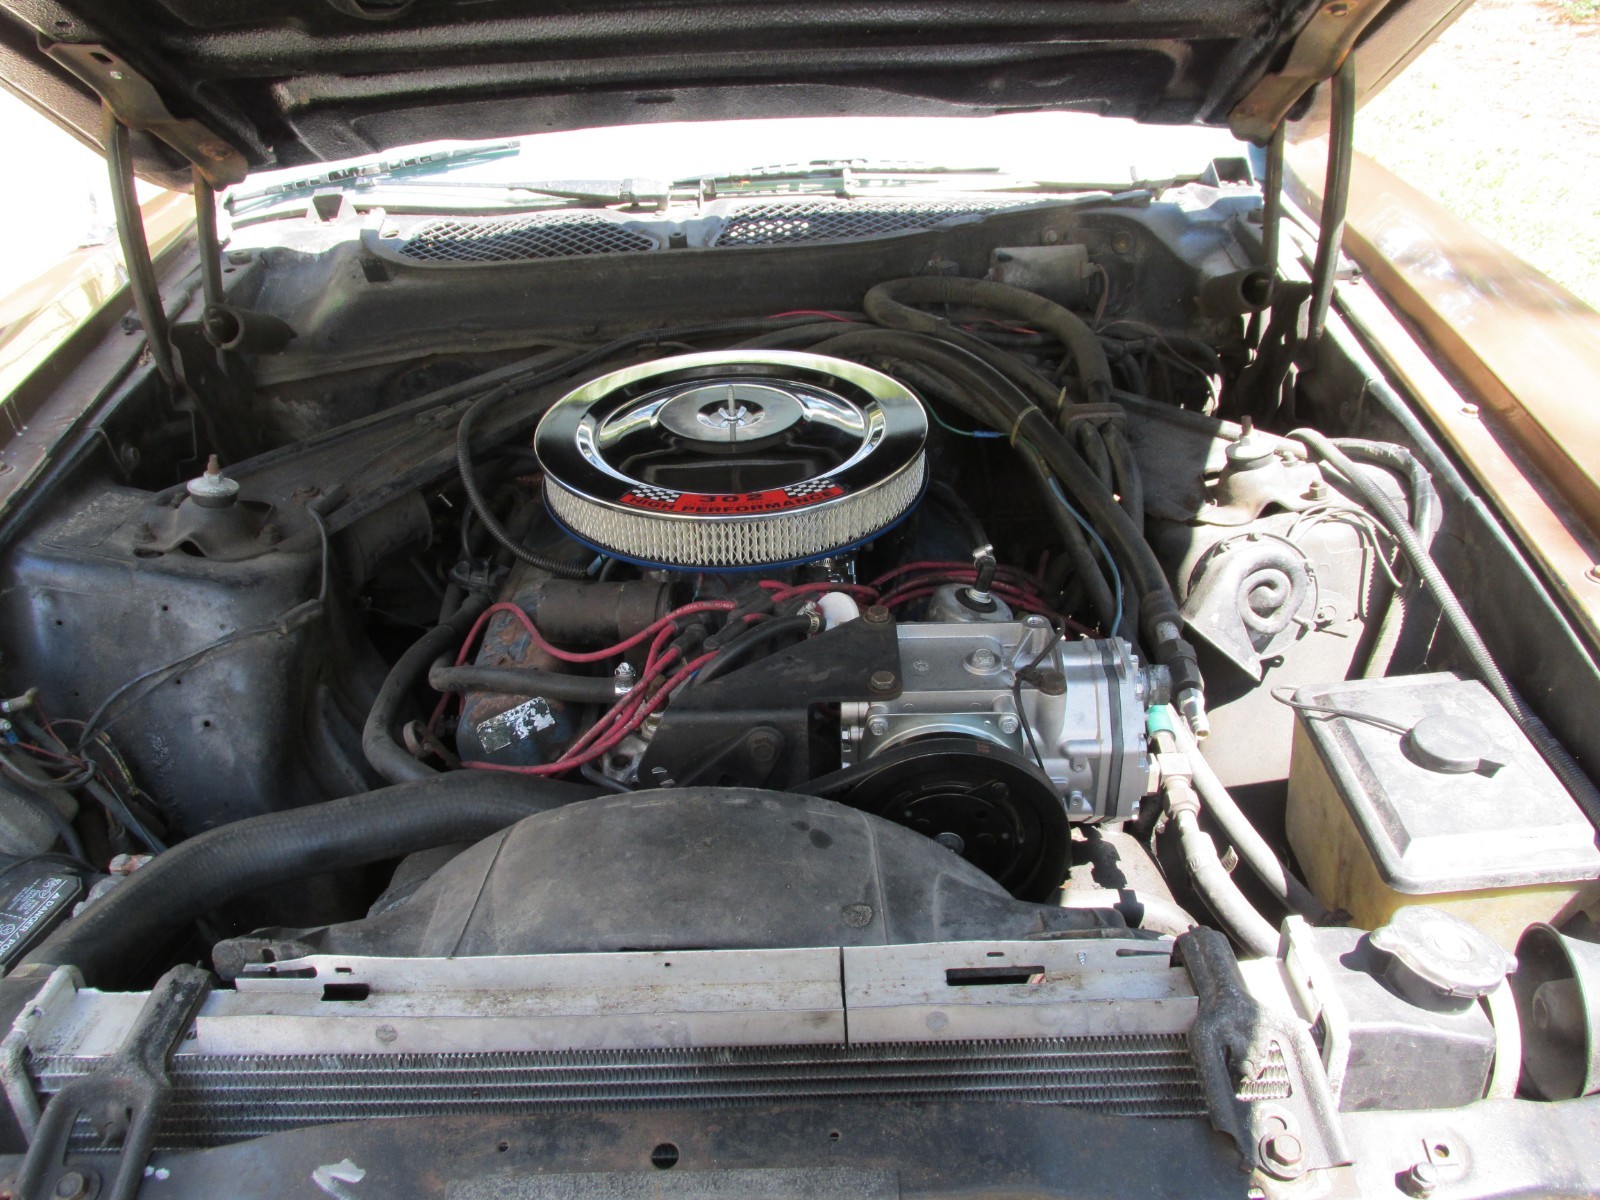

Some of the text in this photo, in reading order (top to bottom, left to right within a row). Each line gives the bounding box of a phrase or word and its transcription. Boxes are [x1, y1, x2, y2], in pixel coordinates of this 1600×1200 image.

[629, 495, 677, 511] HIGH
[680, 490, 832, 513] PERFORMANCE
[698, 493, 764, 503] 302
[20, 900, 55, 932] DANGER
